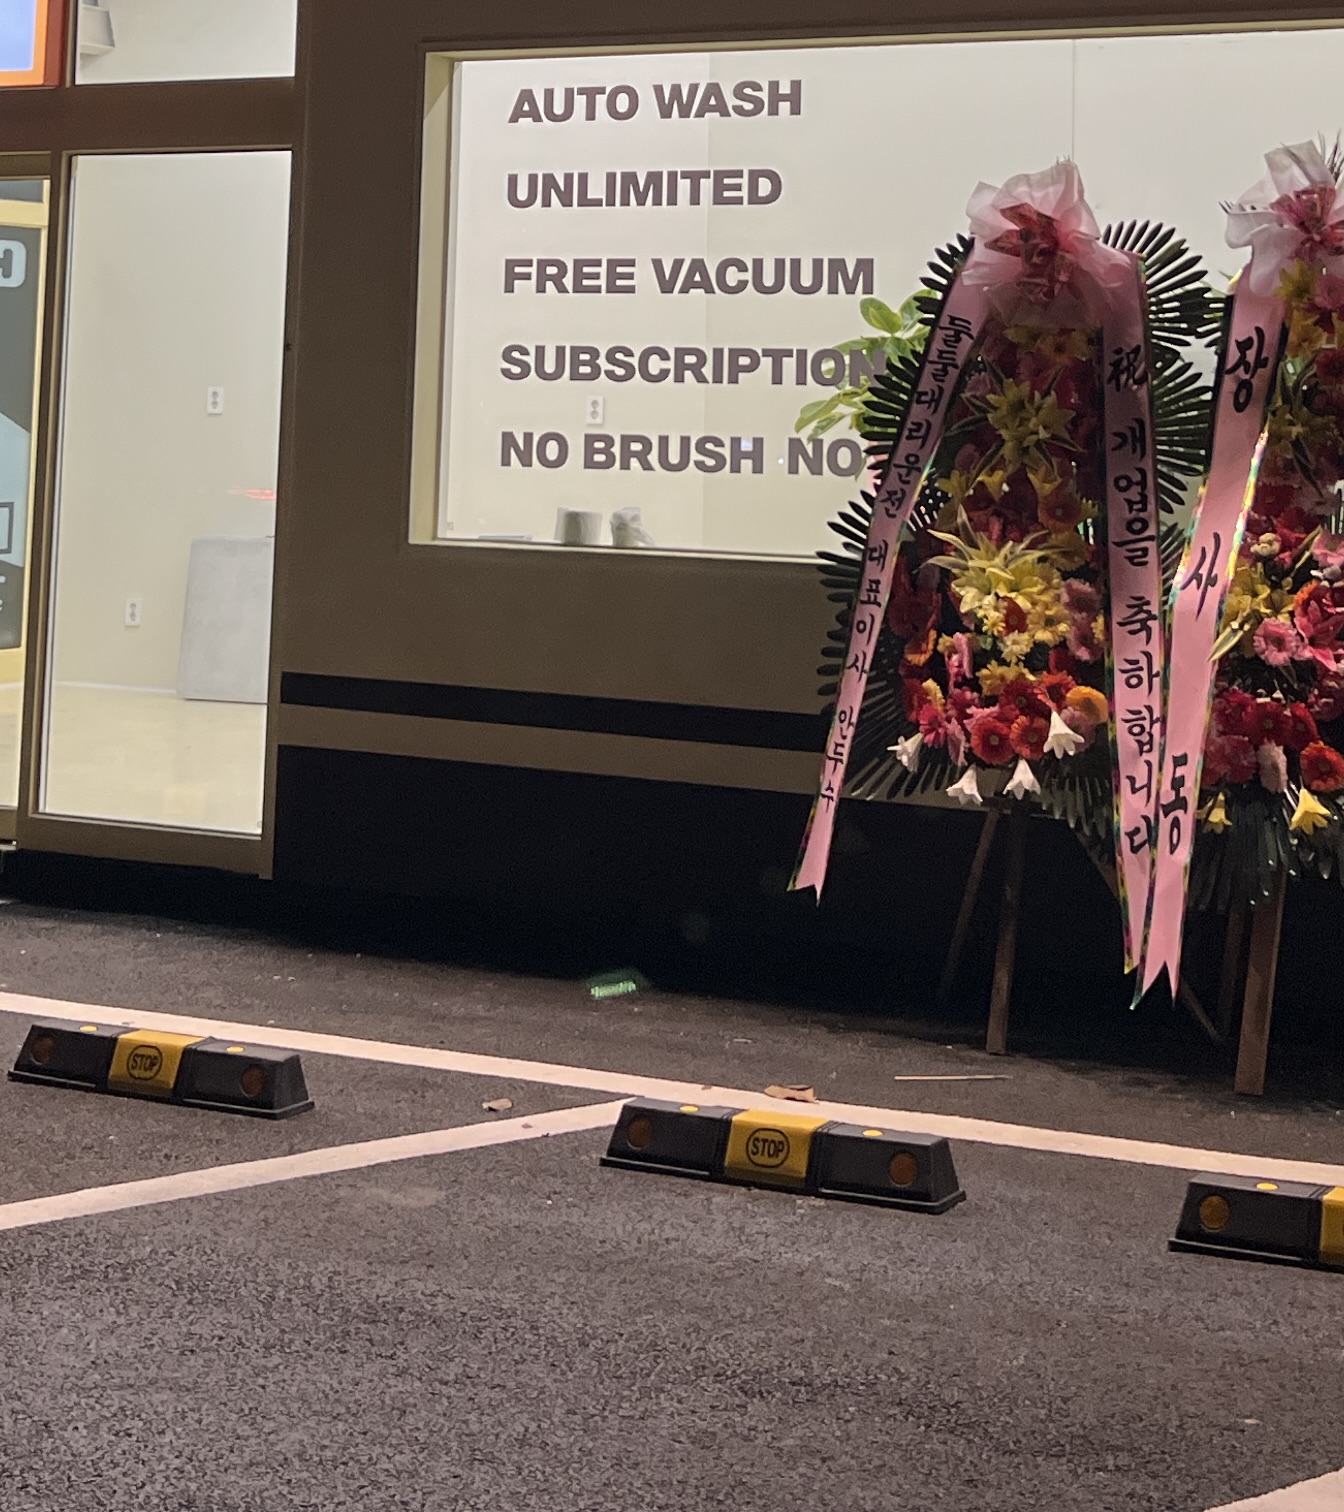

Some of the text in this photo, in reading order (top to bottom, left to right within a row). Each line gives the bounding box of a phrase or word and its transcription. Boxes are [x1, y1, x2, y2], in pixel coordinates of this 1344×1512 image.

[508, 79, 803, 124] AUTO WASH
[507, 168, 783, 208] UNLIMITED
[503, 257, 875, 295] FREE VACUUM
[500, 344, 886, 386] SUBSCRIPTION
[500, 431, 862, 476] NO BRUSH NO
[845, 540, 887, 682] 대표이사
[1107, 345, 1161, 856] 祝 개업을 축하합니다
[131, 1052, 159, 1073] STOP
[749, 1139, 786, 1157] STOP
